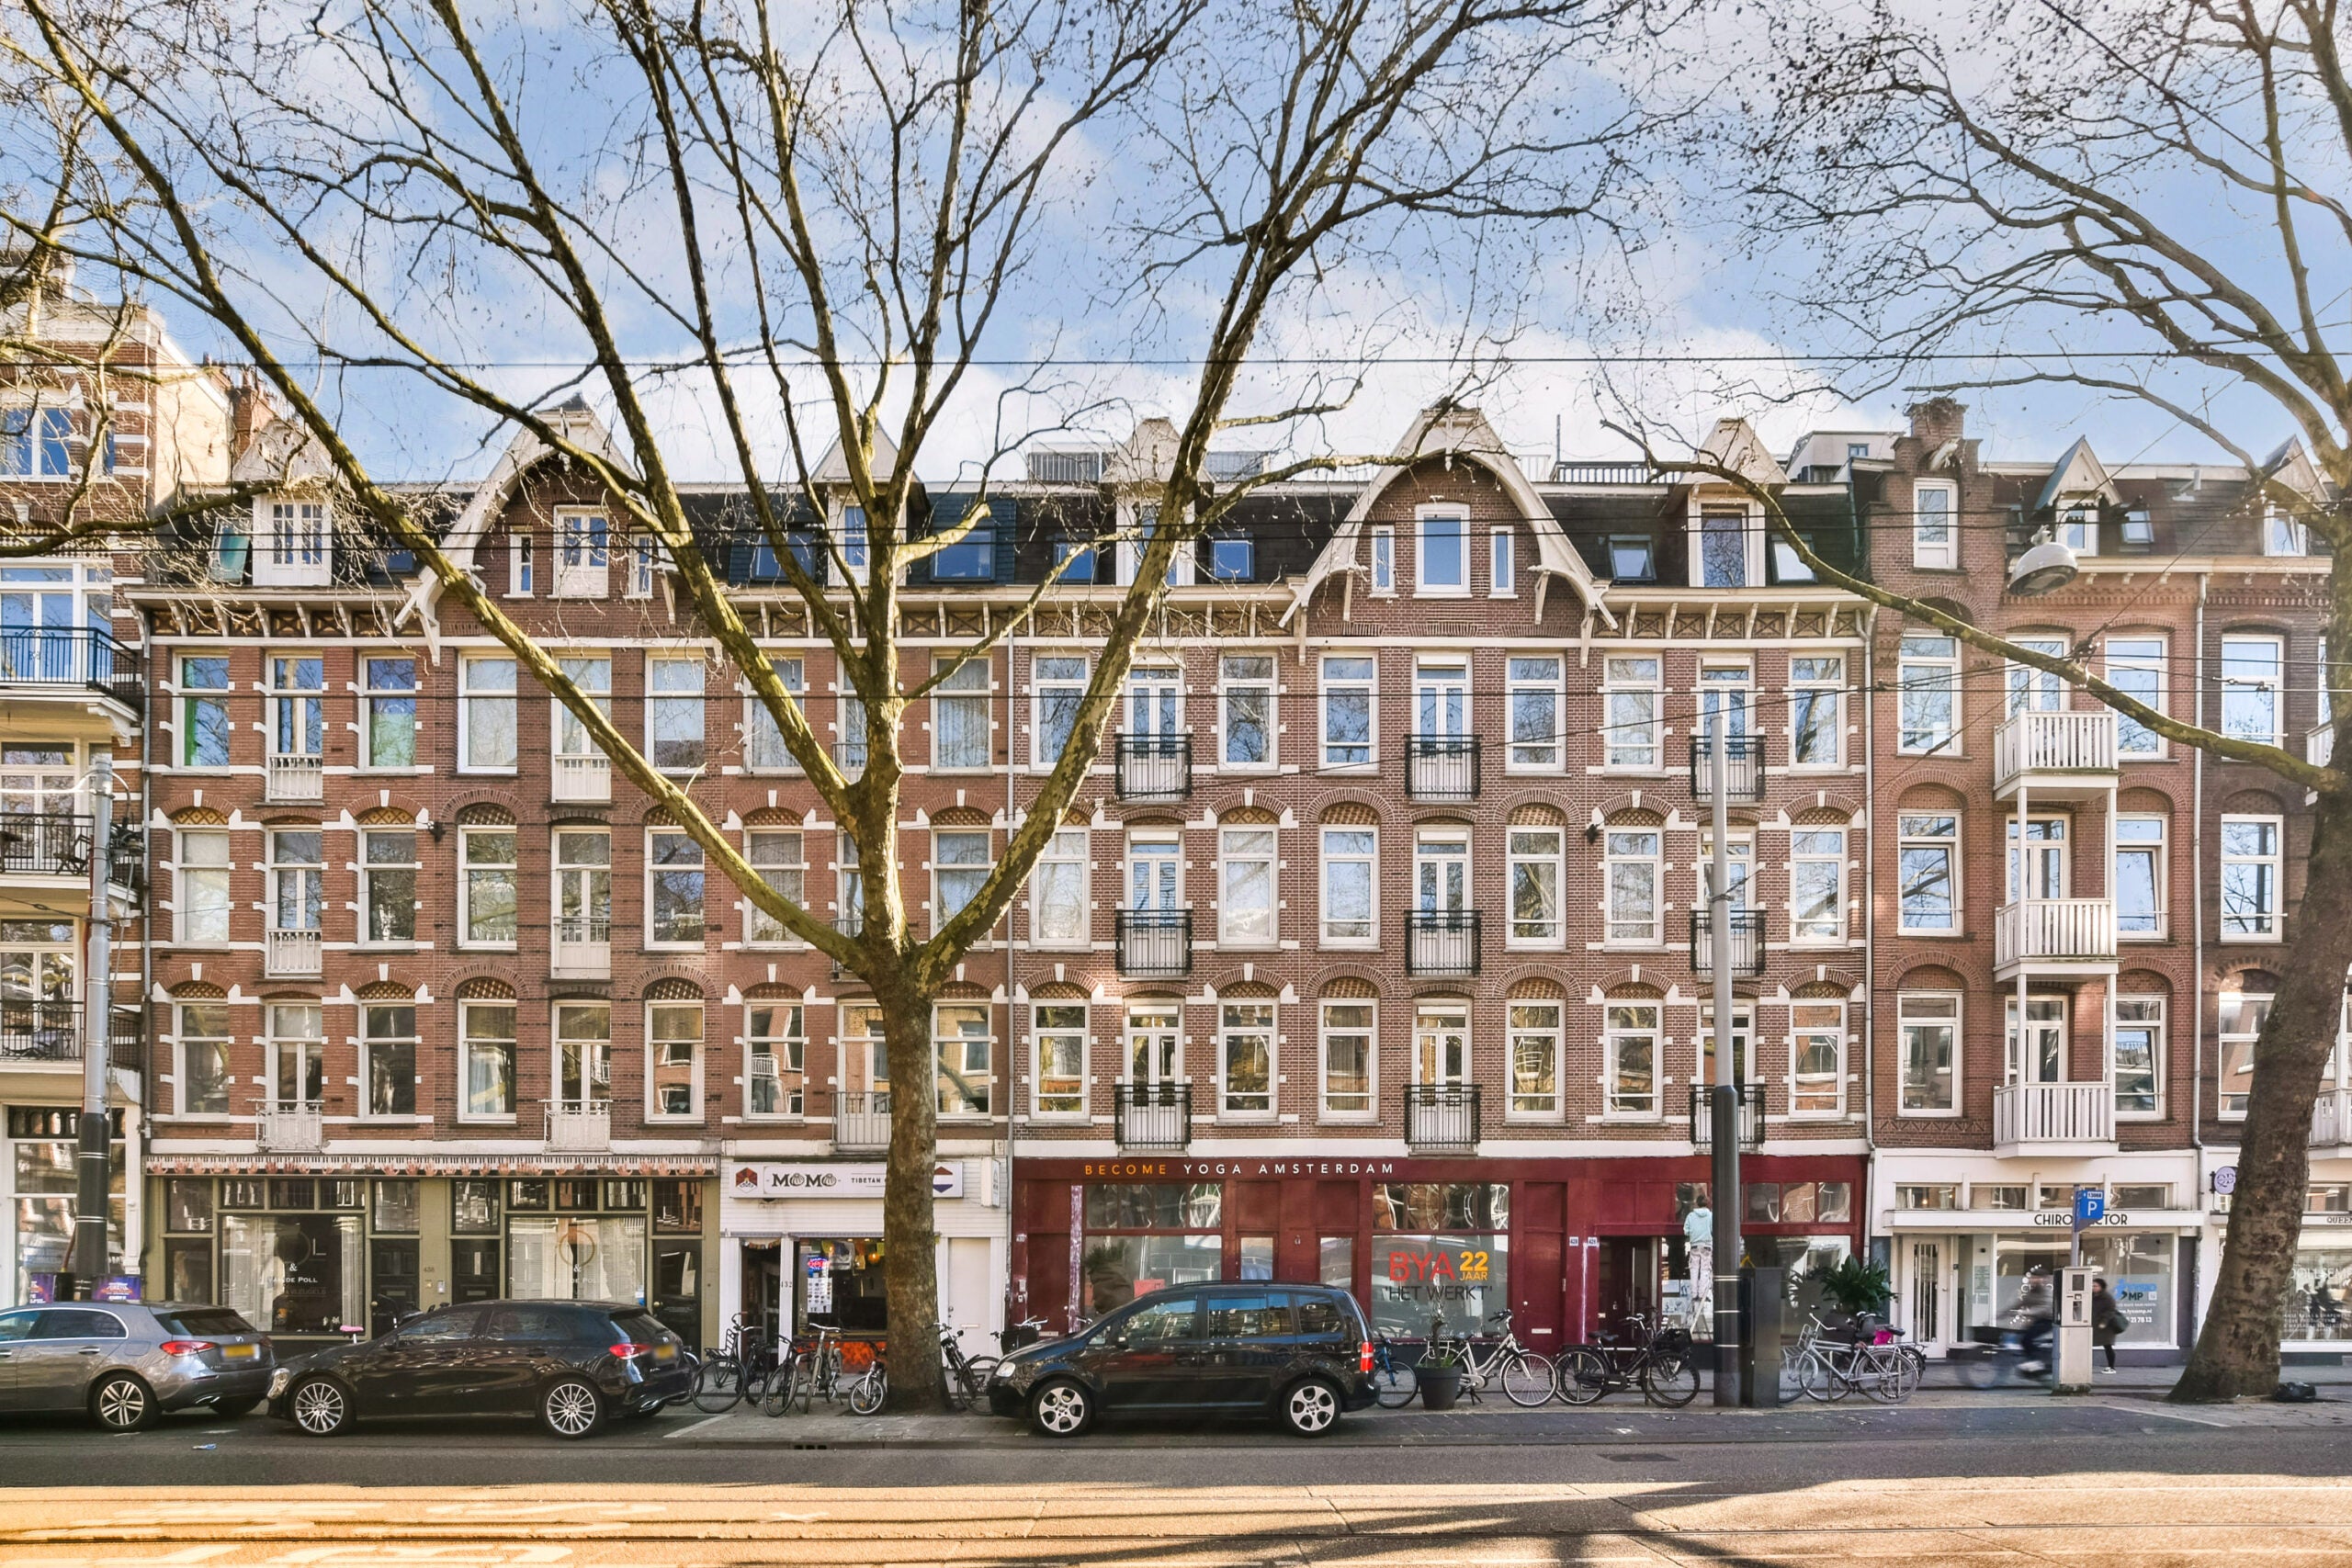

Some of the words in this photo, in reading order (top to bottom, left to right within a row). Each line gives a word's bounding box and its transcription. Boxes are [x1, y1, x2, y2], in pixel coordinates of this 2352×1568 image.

[1085, 1164, 1166, 1175] BECOME
[1183, 1164, 1243, 1175] YOGA
[1258, 1163, 1393, 1174] AMSTERDAM
[771, 1172, 837, 1187] MOMO
[2088, 1201, 2098, 1216] P
[2034, 1213, 2128, 1225] CHIROTOR
[289, 1263, 298, 1271] &
[1388, 1250, 1456, 1281] BYA
[1459, 1250, 1488, 1272] 22
[1459, 1272, 1488, 1281] JAAR
